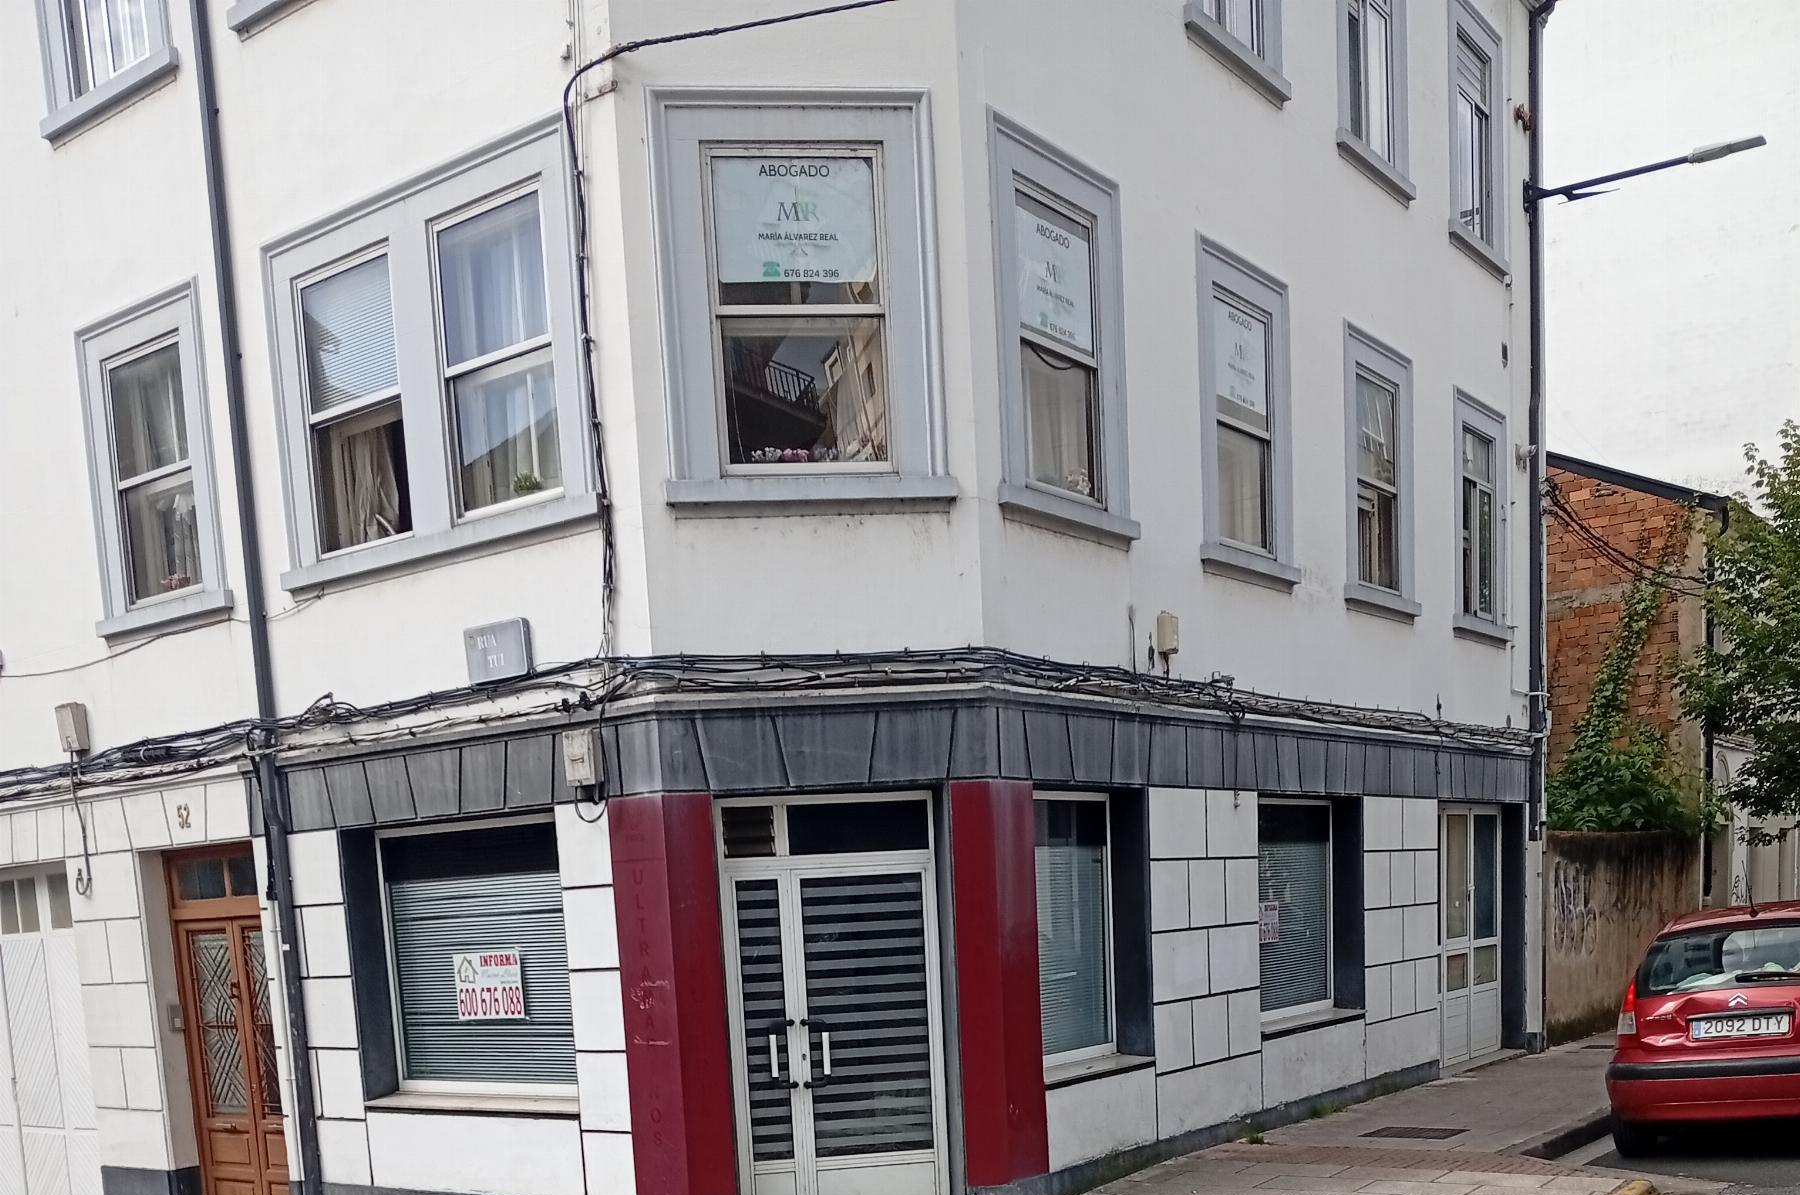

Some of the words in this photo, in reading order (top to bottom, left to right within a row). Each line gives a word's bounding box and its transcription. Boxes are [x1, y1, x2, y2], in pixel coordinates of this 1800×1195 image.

[758, 164, 830, 177] ABOGADO
[1036, 223, 1070, 249] ABOGADO
[784, 269, 801, 278] 676
[803, 269, 820, 278] 824
[822, 269, 839, 278] 396
[176, 803, 191, 829] 52
[480, 954, 518, 967] INFORMA
[460, 987, 479, 1017] 600
[480, 986, 500, 1016] 676
[501, 985, 523, 1016] 088
[1704, 1017, 1746, 1035] 2092
[1752, 1015, 1784, 1032] DTY
